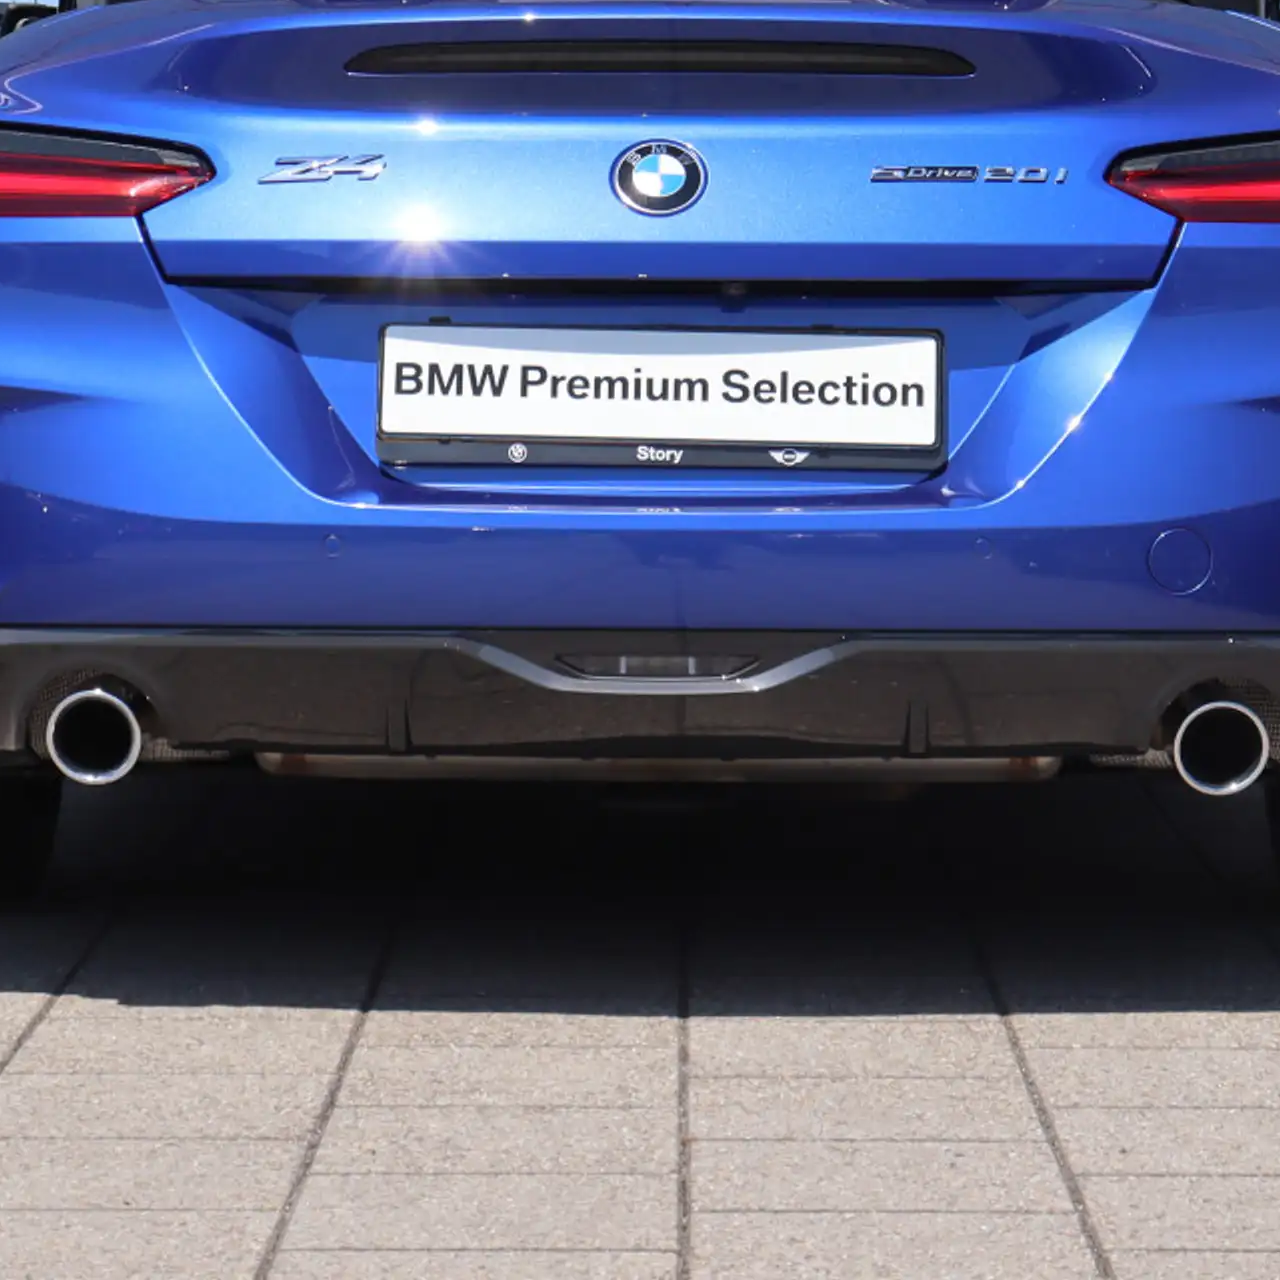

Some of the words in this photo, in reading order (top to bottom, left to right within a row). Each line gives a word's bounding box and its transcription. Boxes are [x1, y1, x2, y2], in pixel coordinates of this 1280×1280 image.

[257, 153, 387, 185] Z4
[395, 362, 509, 398] BMW
[519, 363, 710, 403] Premium
[721, 369, 925, 408] Selection
[636, 445, 683, 465] Story
